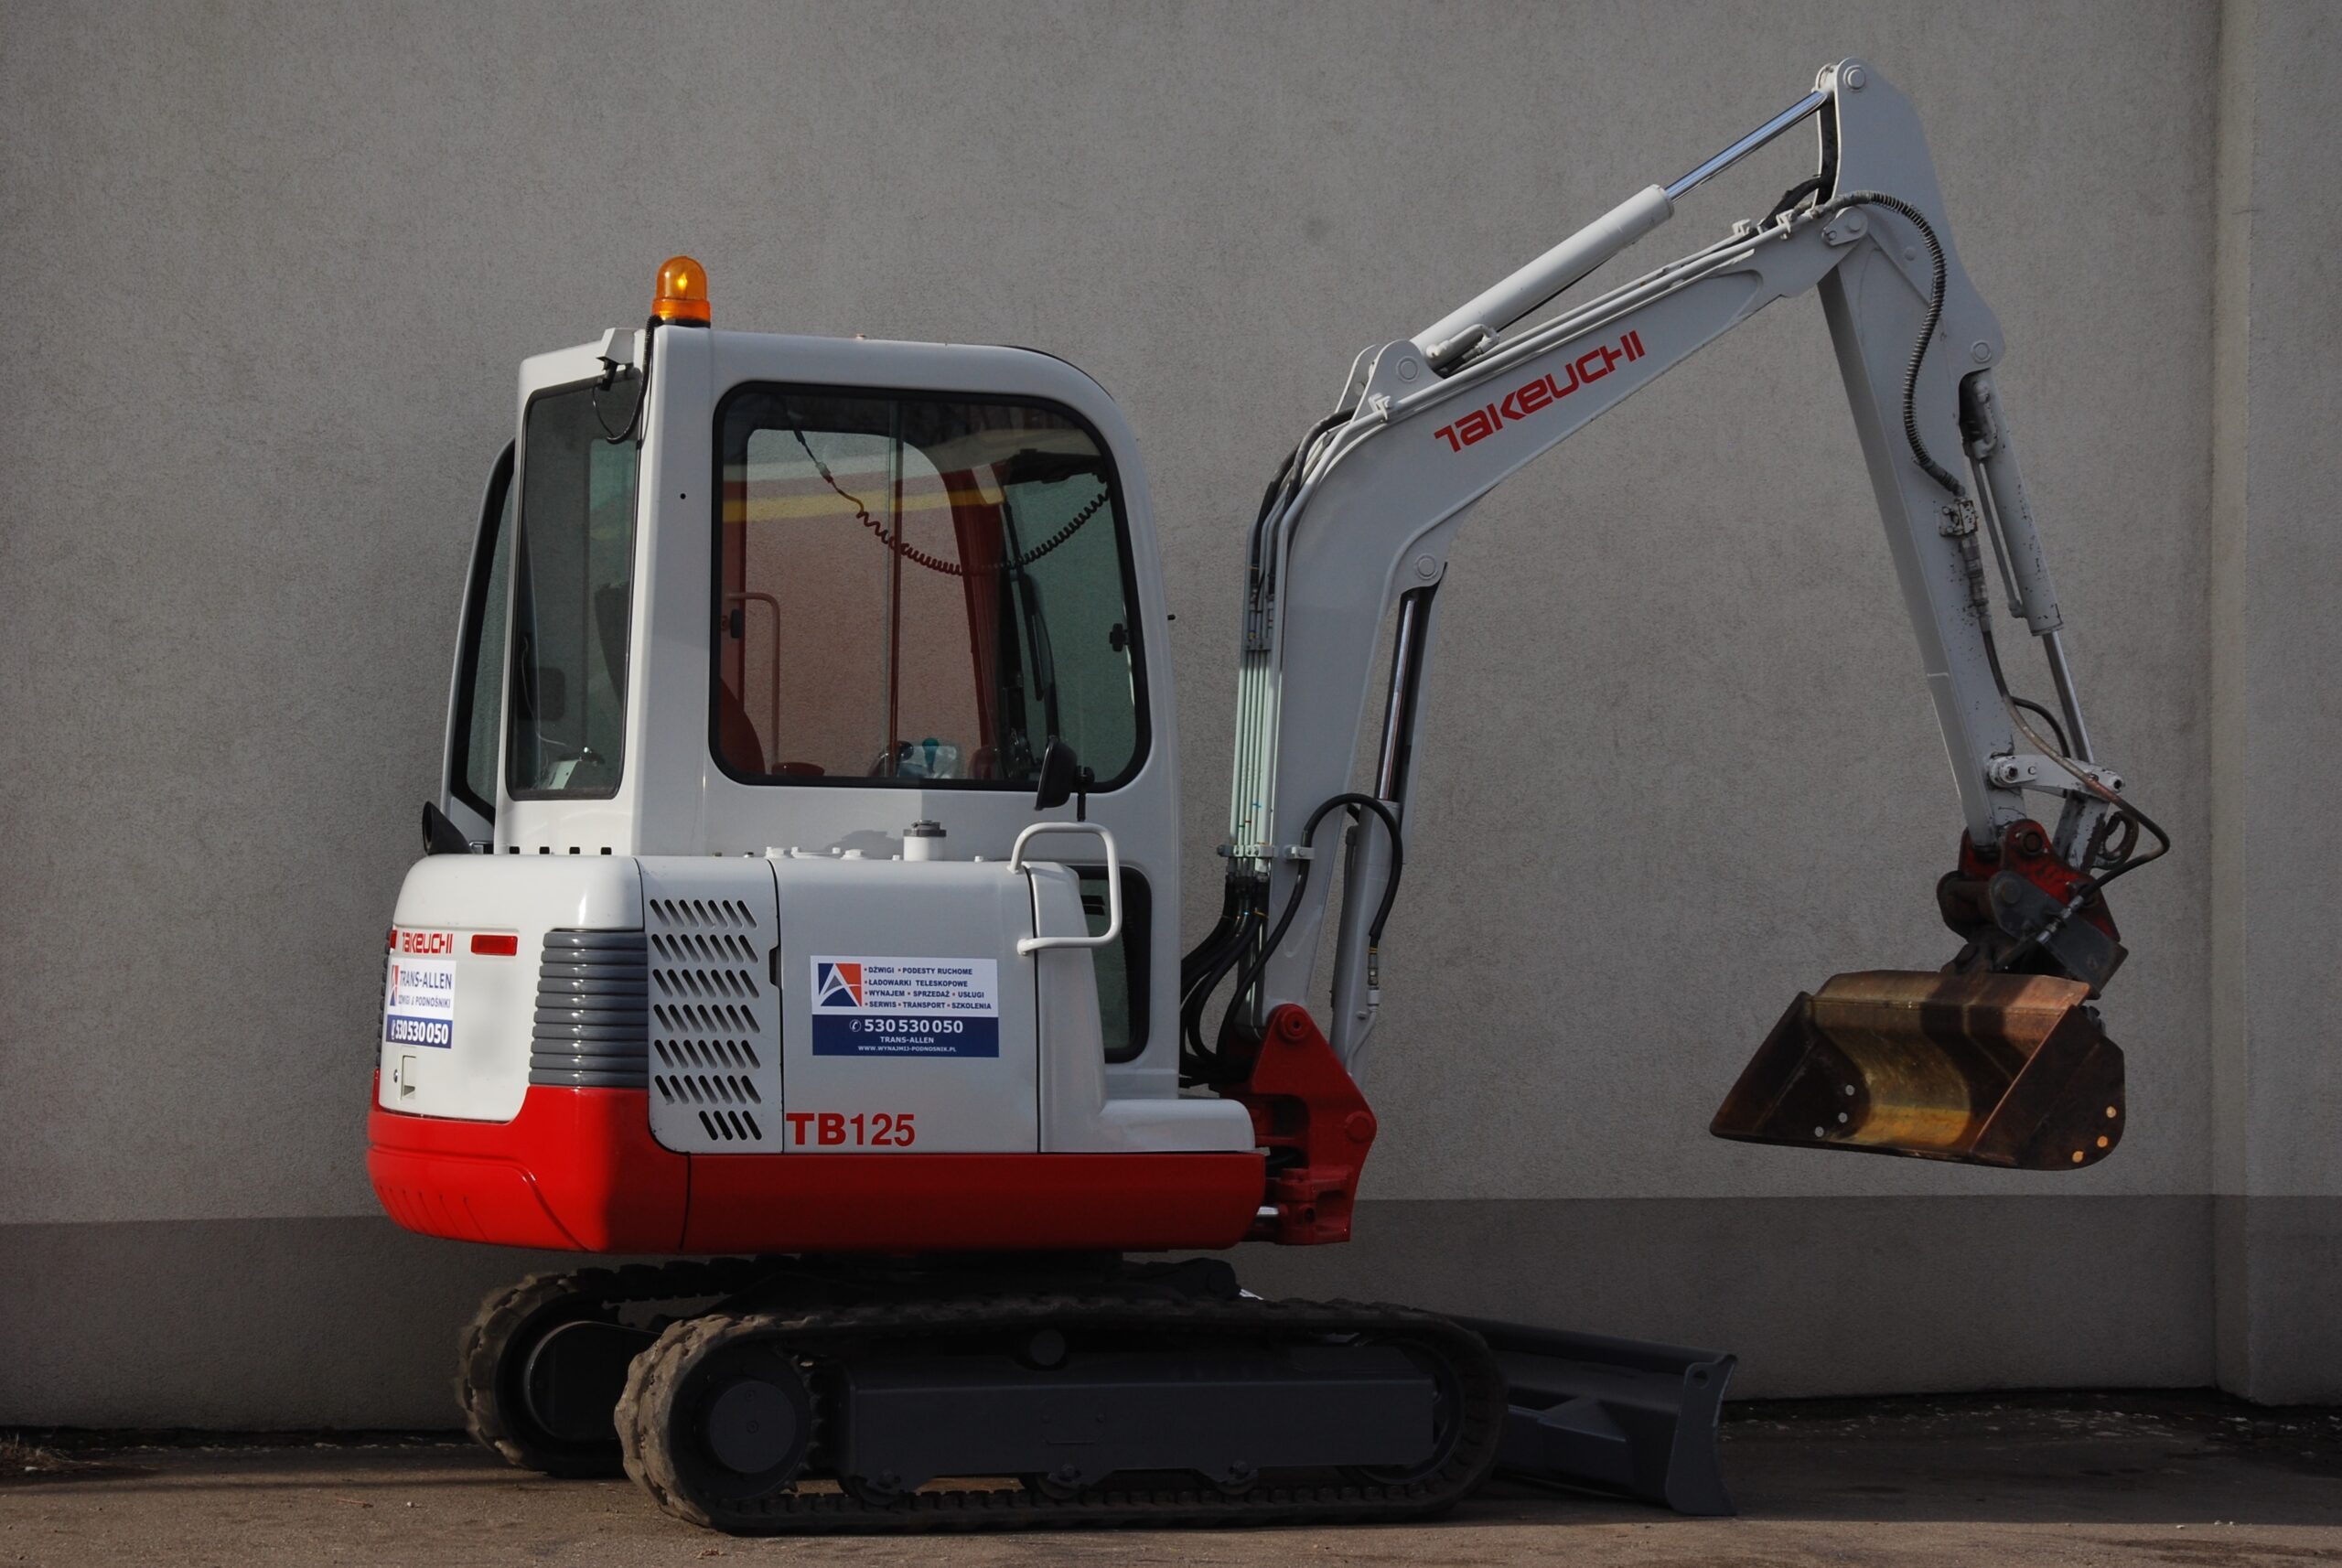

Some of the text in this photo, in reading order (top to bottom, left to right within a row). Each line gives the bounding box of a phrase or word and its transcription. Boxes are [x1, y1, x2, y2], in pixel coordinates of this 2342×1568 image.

[400, 971, 452, 990] TRANS-ALLEN
[913, 990, 951, 998] SPRZEDAŻ
[902, 1001, 946, 1009] TRANSPORT
[951, 1002, 992, 1010] SZKOLENIA
[426, 1022, 449, 1045] 050
[865, 1019, 963, 1034] 530 530 050
[786, 1112, 915, 1147] TB125
